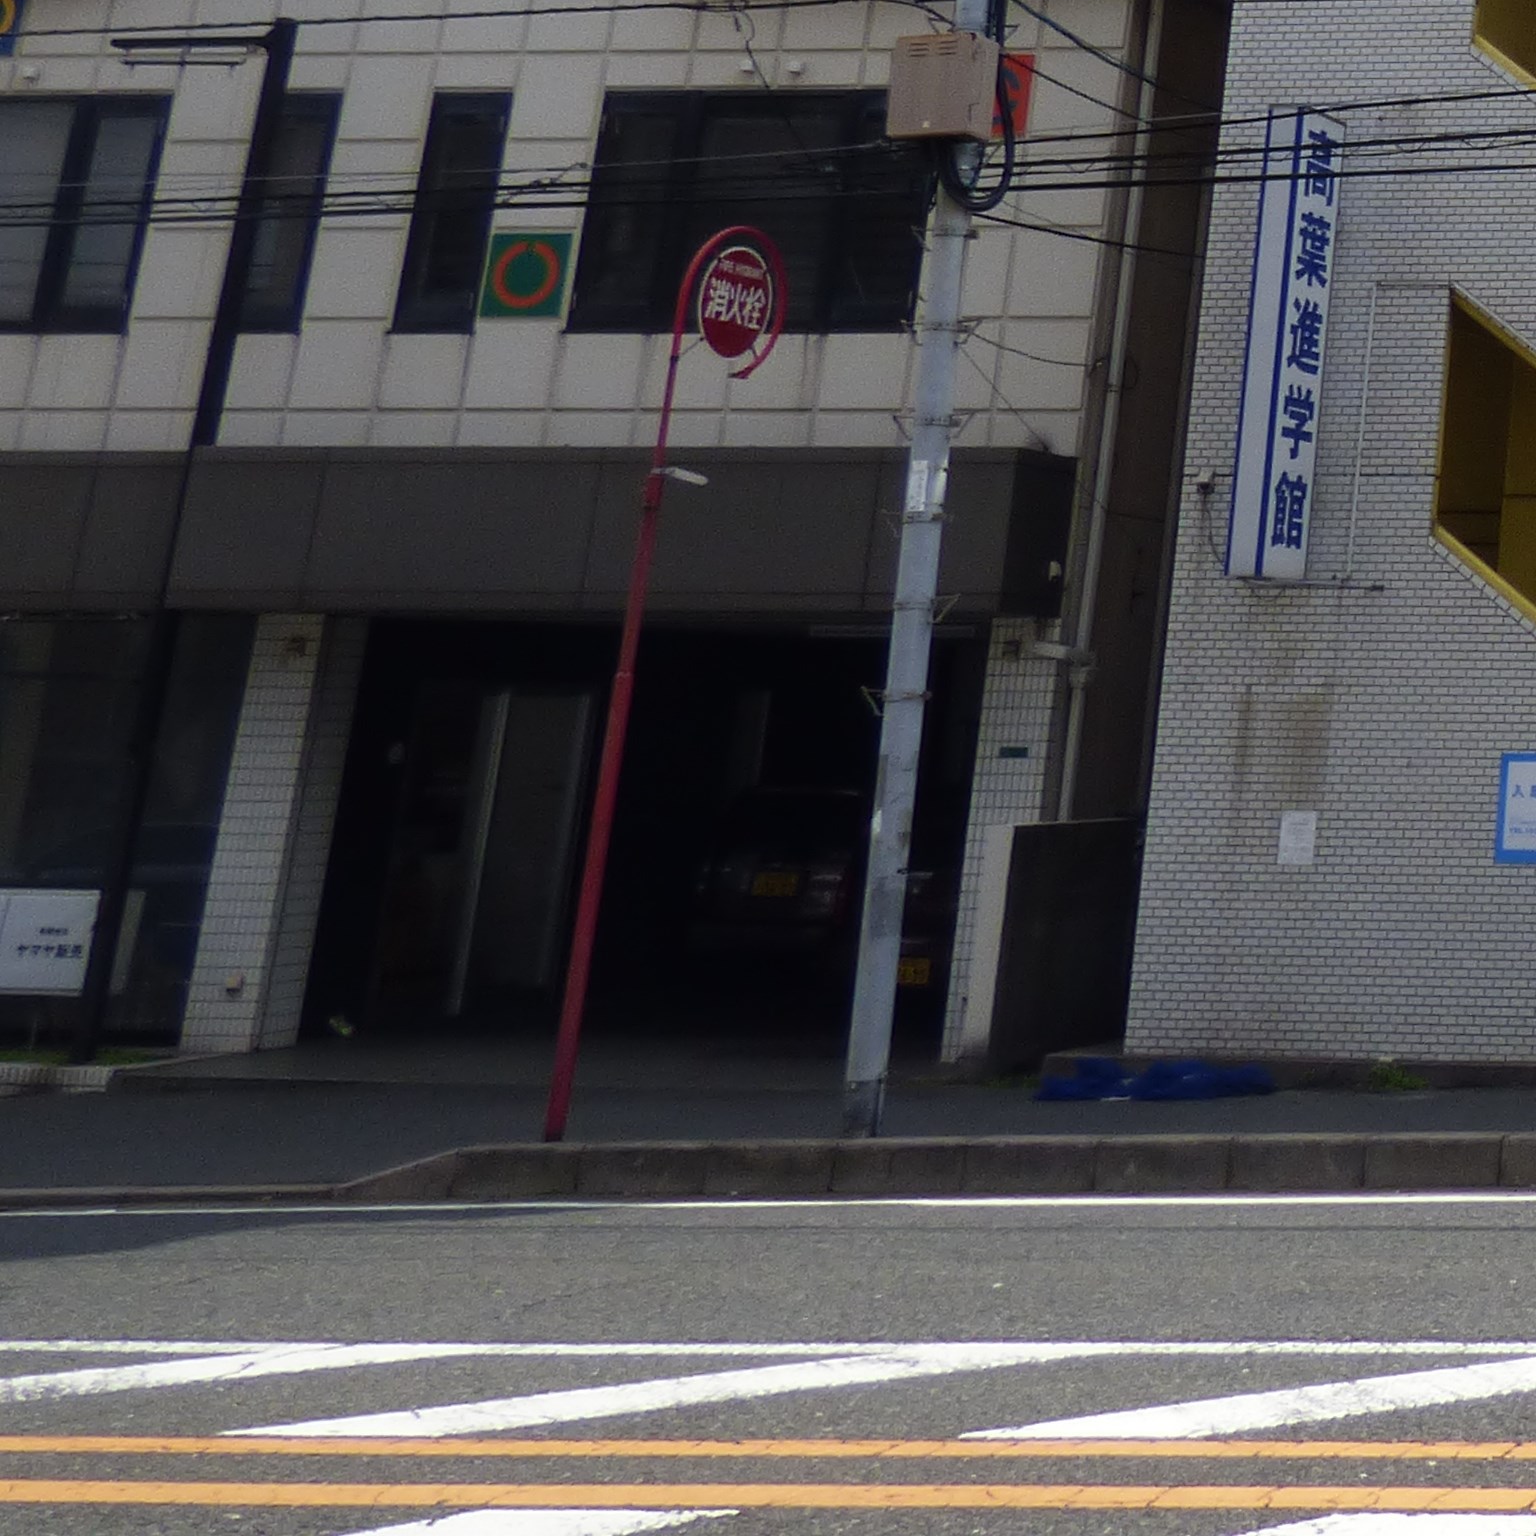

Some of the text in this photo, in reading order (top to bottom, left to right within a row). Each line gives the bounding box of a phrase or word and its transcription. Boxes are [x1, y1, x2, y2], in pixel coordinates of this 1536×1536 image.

[704, 276, 767, 331] 消火栓
[1271, 129, 1339, 550] 高葉進学館
